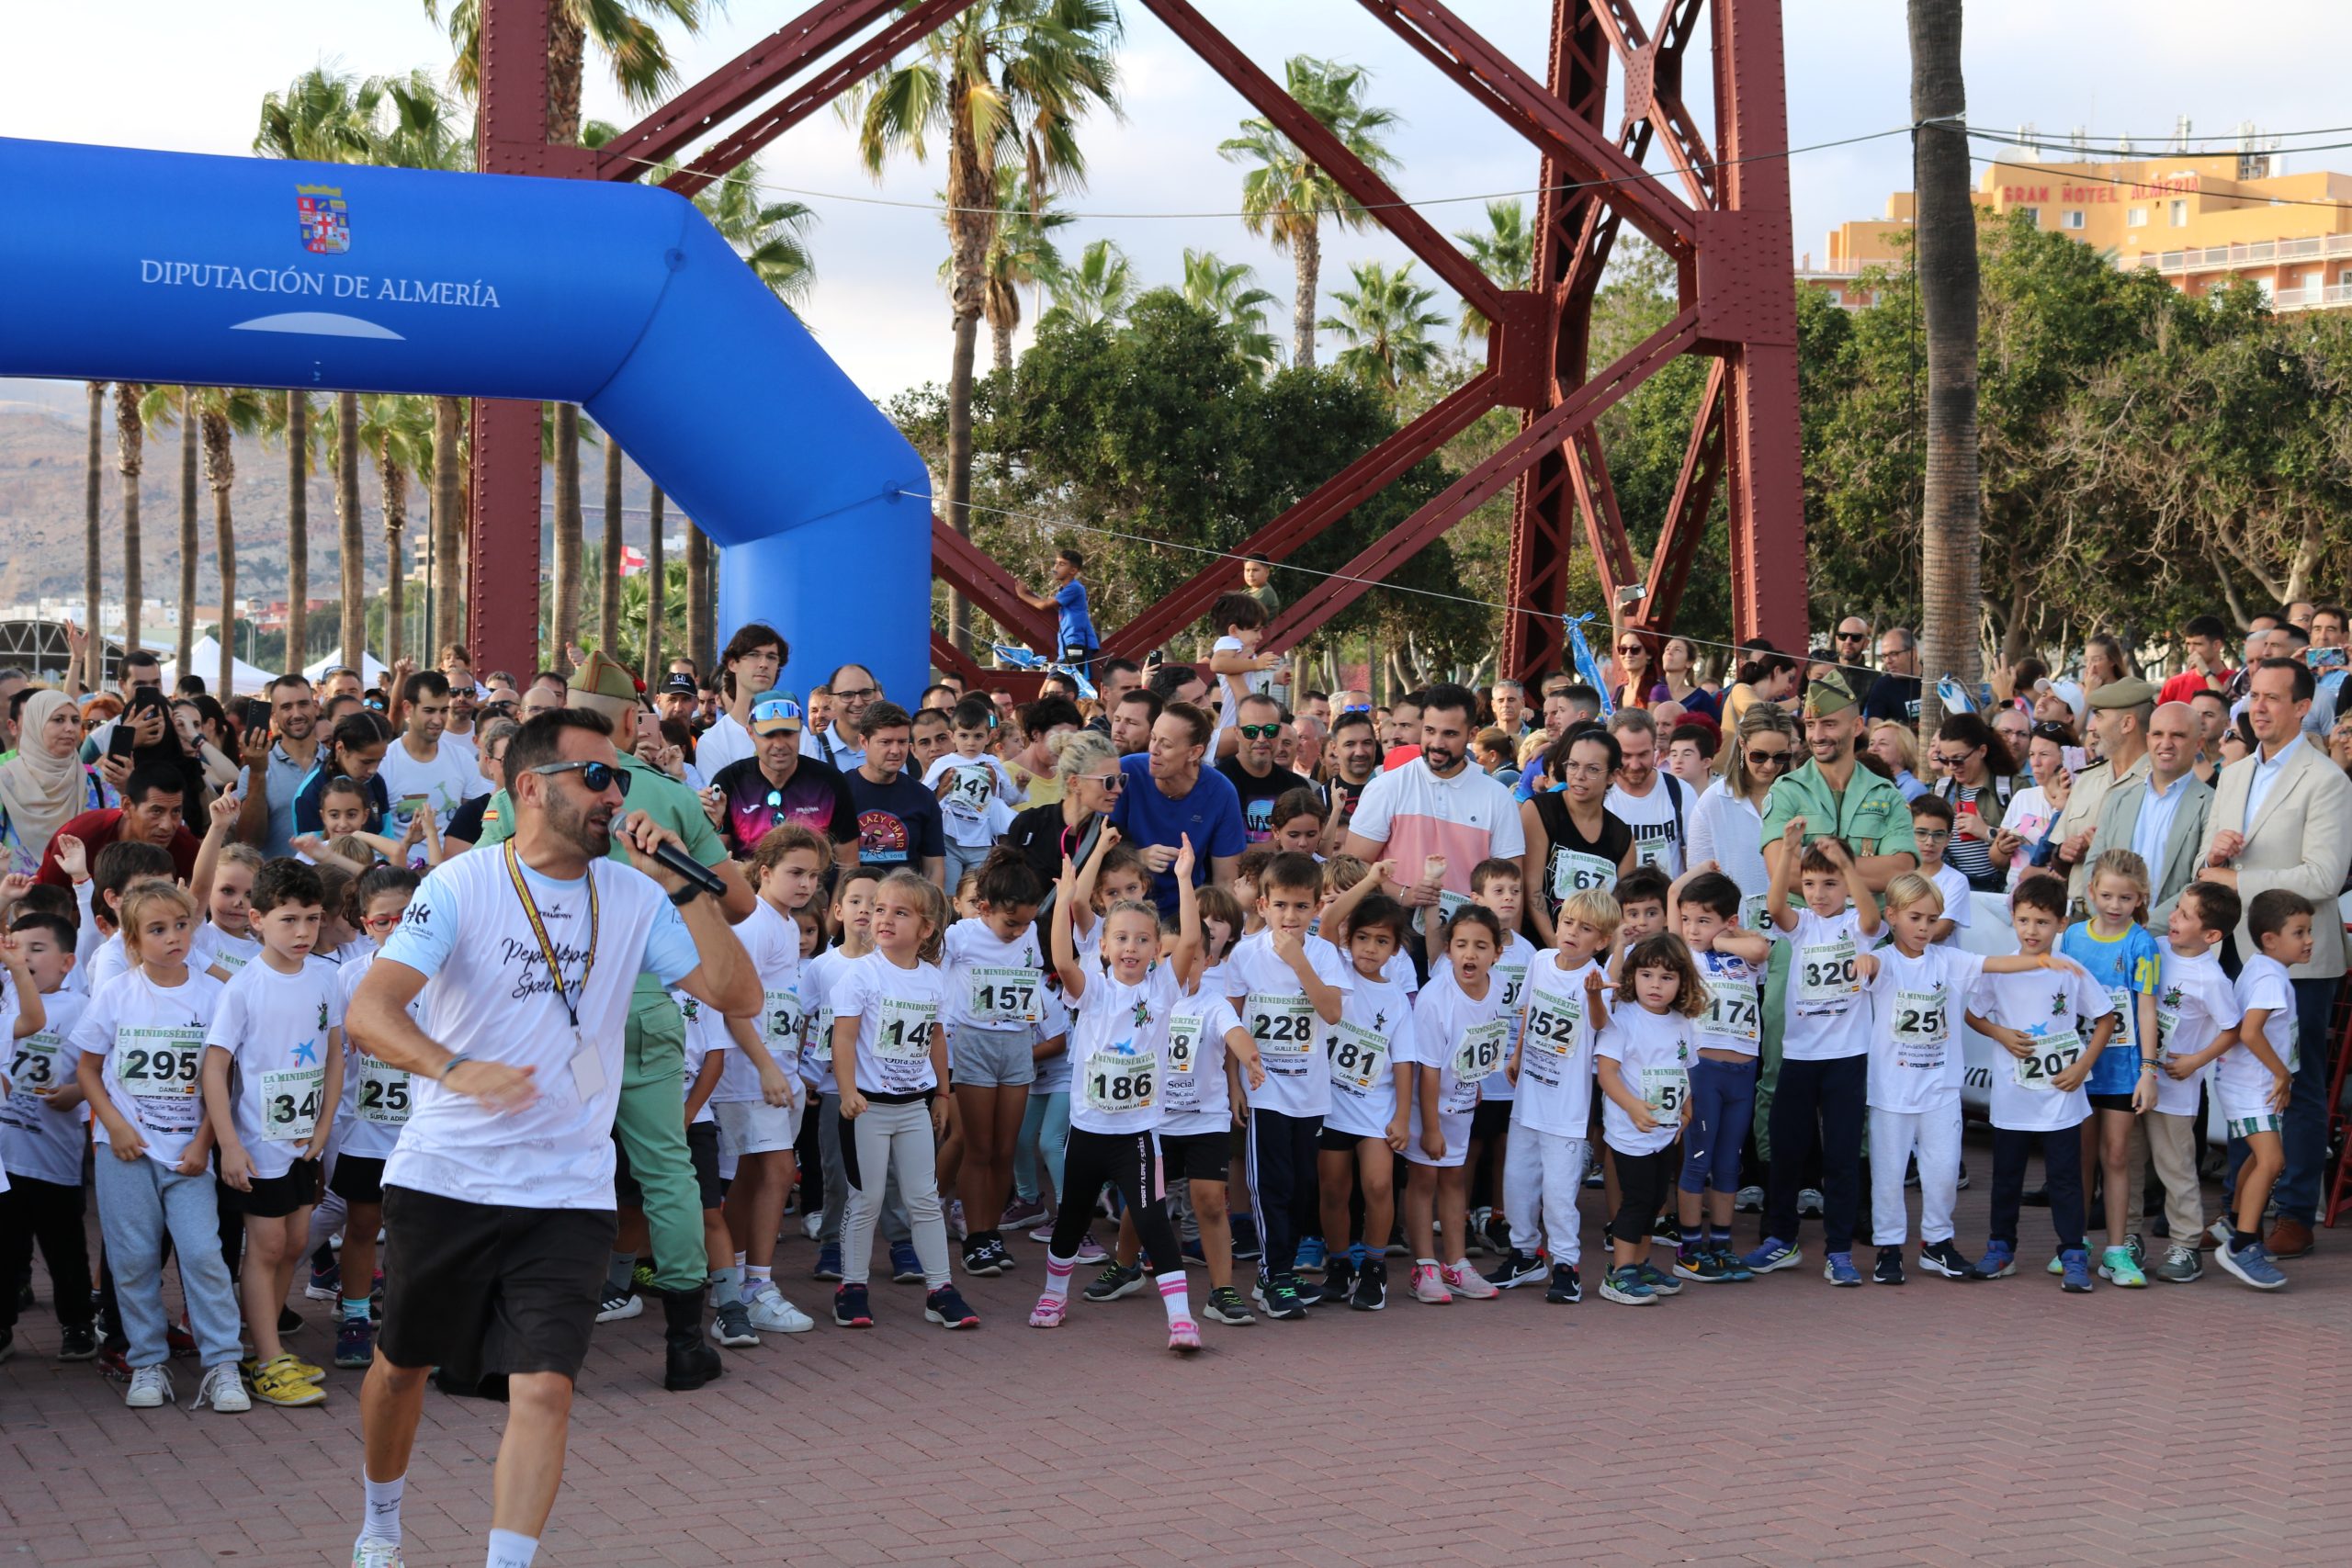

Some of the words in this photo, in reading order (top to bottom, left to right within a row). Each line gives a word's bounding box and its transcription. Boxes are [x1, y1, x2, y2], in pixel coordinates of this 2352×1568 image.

[2004, 186, 2050, 203] GRAN
[2062, 186, 2119, 203] HOTEL
[141, 260, 324, 296] DIPUTACIÓN
[334, 275, 369, 299] DE
[377, 279, 500, 309] ALMERÍA
[859, 814, 887, 827] LAZY
[888, 820, 904, 849] CHAIR
[1574, 870, 1605, 890] 67
[1807, 959, 1858, 987] 320
[883, 998, 893, 1007] LA
[979, 985, 1034, 1010] 157
[1528, 1006, 1573, 1044] 252
[1708, 998, 1757, 1027] 174
[1900, 1006, 1946, 1033] 251
[119, 1028, 130, 1037] LA
[1254, 1014, 1311, 1041] 228
[125, 1049, 197, 1081] 295
[1327, 1036, 1375, 1076] 181
[1463, 1038, 1499, 1068] 168
[2024, 1047, 2080, 1078] 207
[264, 1075, 275, 1083] LA
[1094, 1073, 1152, 1100] 186
[1168, 1078, 1194, 1089] Social
[370, 1112, 389, 1121] SUPER
